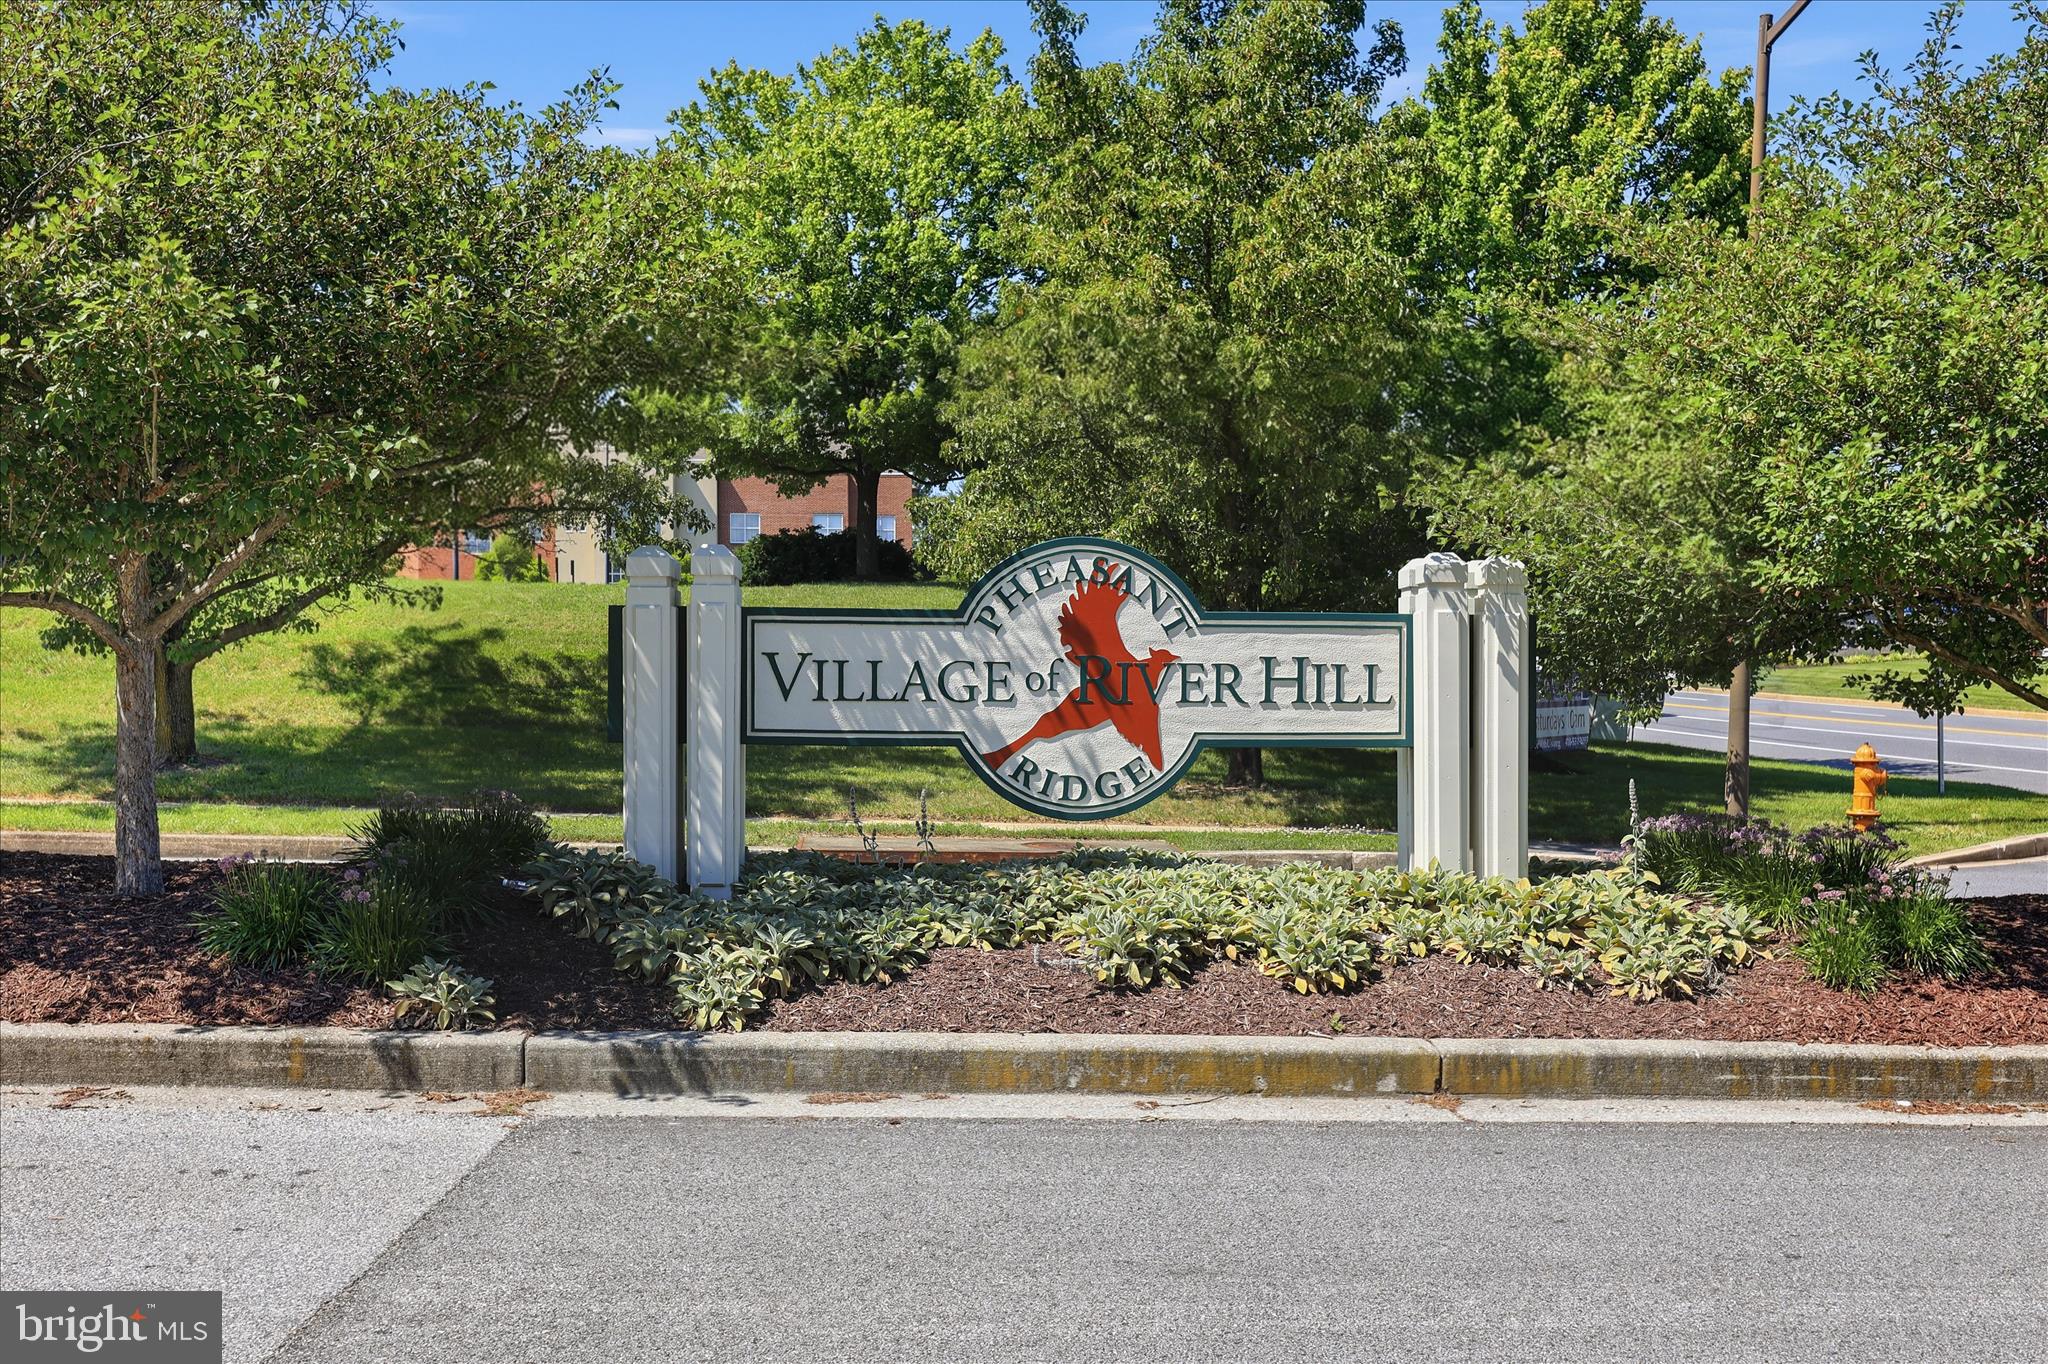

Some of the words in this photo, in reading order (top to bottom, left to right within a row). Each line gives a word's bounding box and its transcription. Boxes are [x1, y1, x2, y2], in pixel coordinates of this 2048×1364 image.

[974, 555, 1193, 640] PHEASANT
[761, 652, 1015, 703] VILLAGE
[1025, 657, 1065, 692] of
[1074, 655, 1249, 705] RIVER
[1259, 656, 1394, 705] HILL
[1536, 710, 1565, 735] aturdays
[1008, 755, 1154, 801] RIDGE
